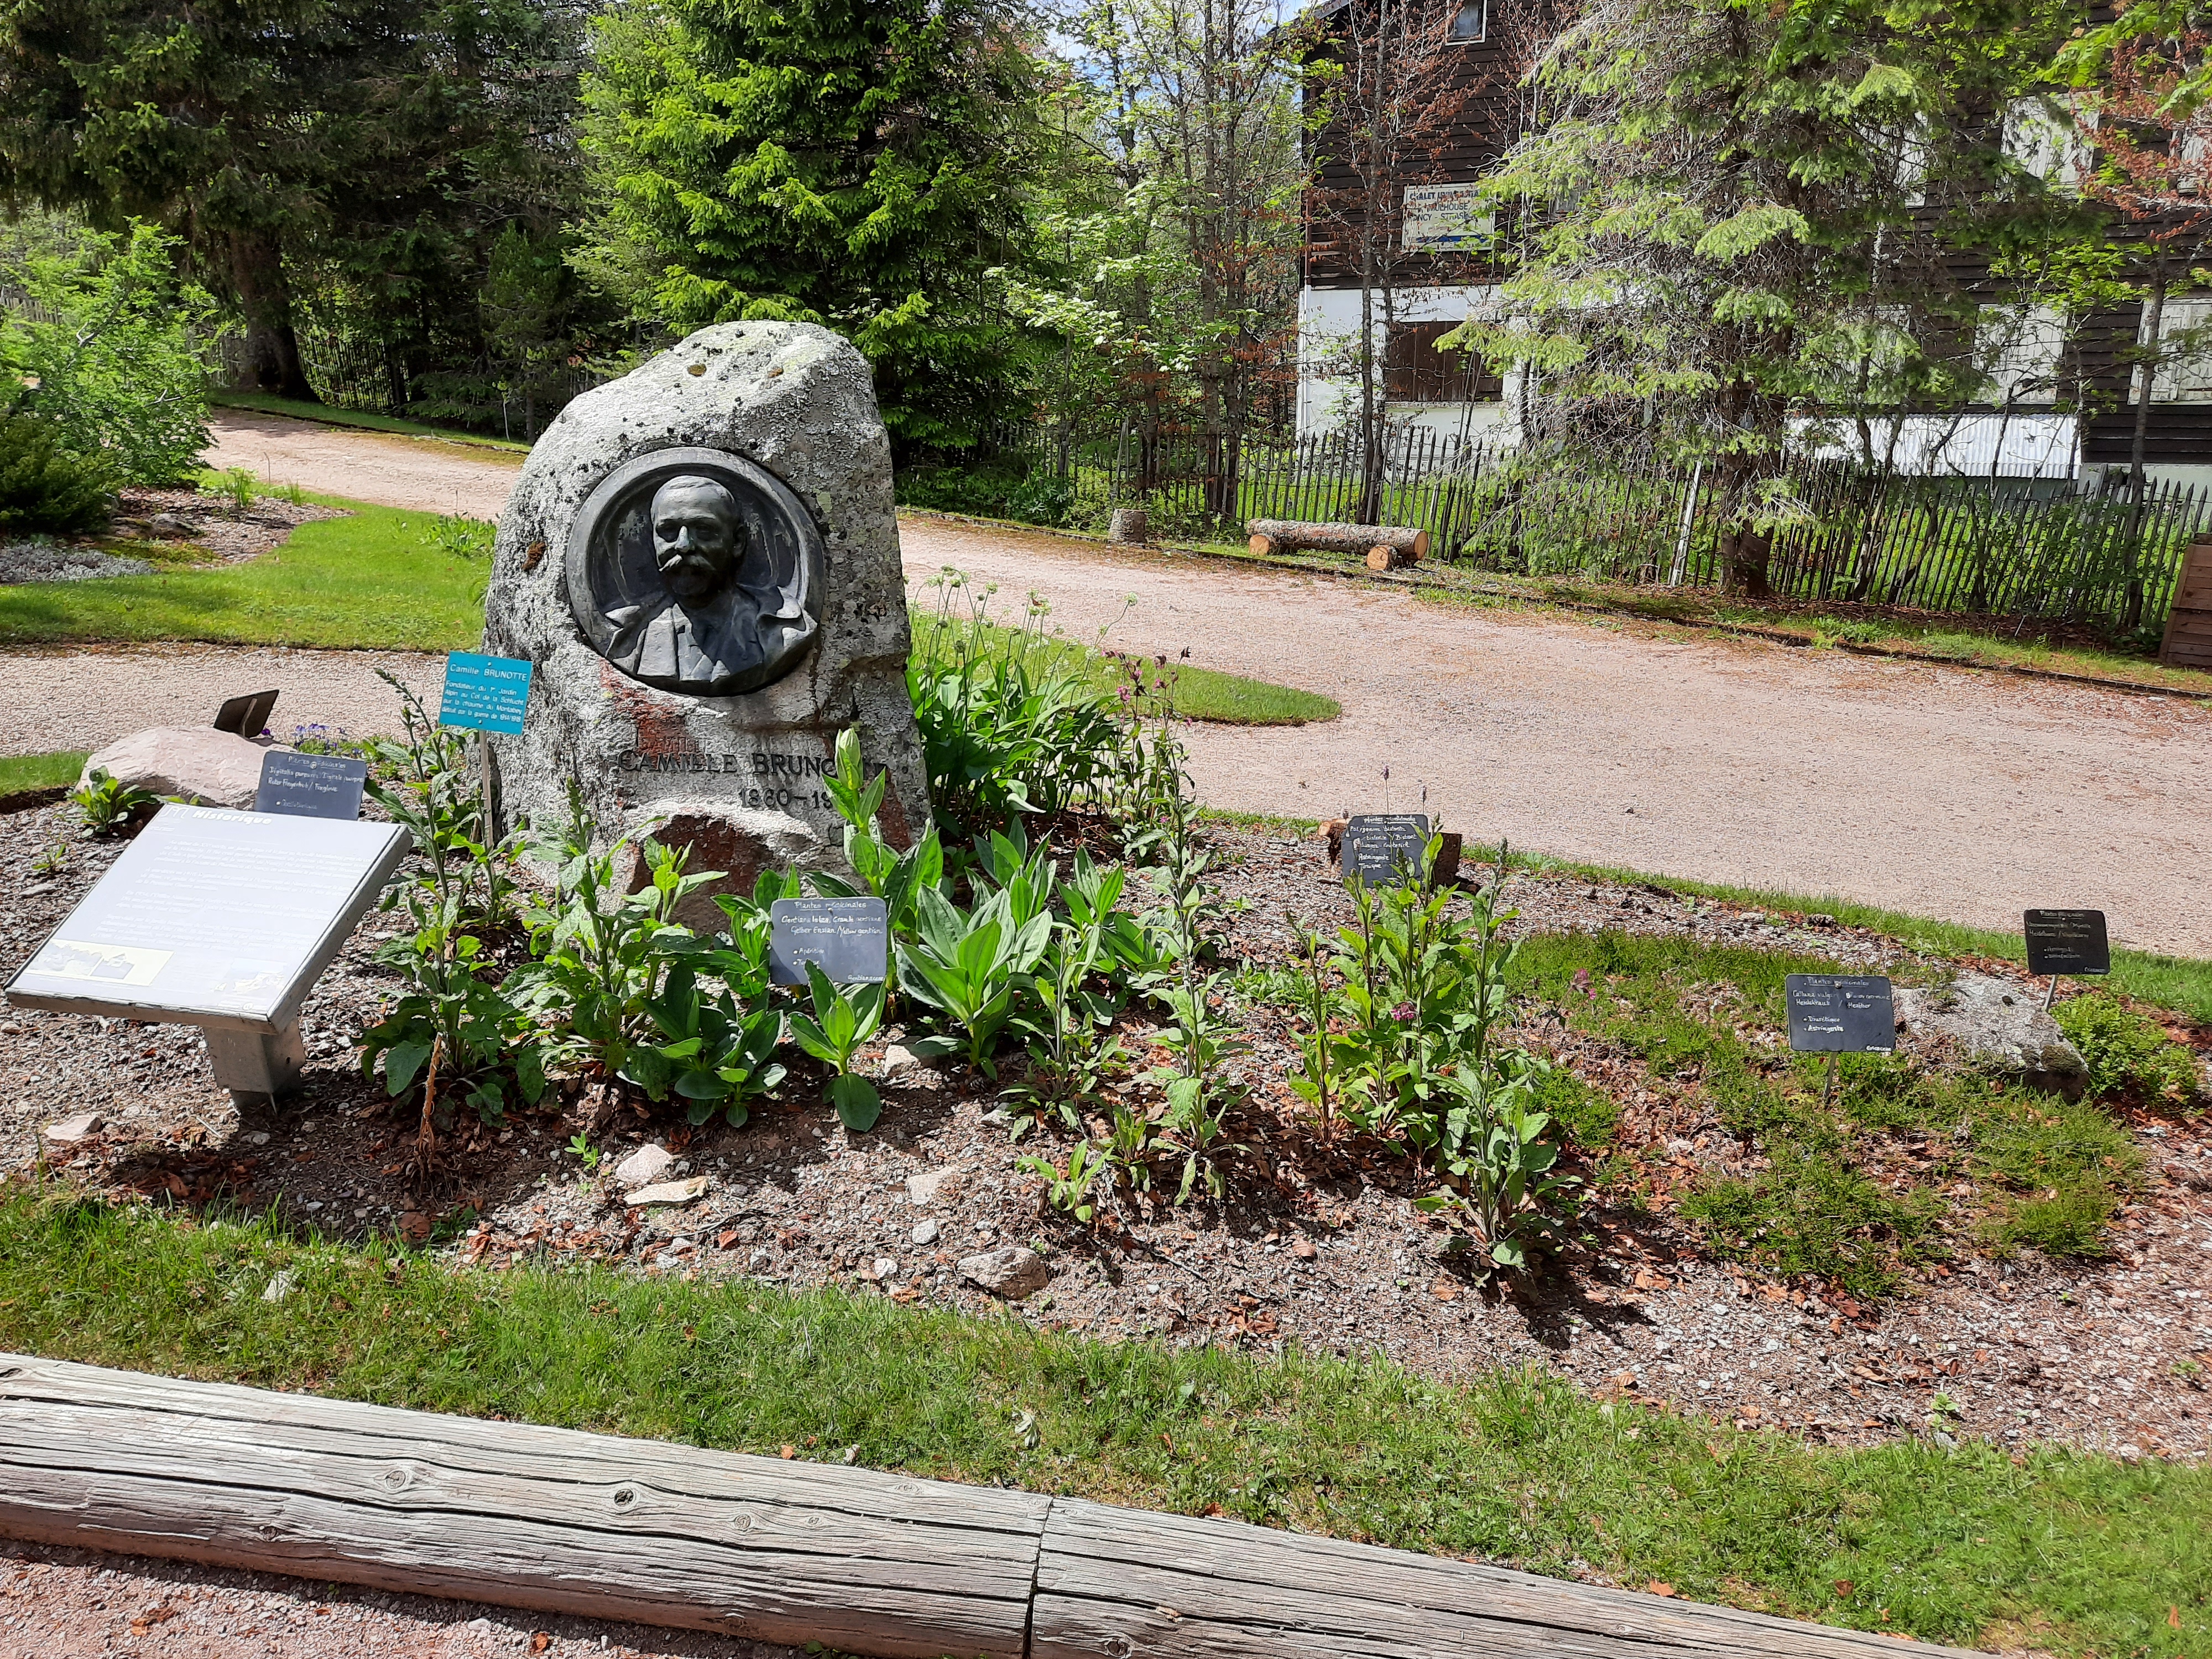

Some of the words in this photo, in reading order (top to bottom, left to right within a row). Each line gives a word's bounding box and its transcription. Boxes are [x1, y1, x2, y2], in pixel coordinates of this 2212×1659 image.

[450, 664, 479, 675] Camille
[484, 668, 528, 681] BRUNOTTE
[445, 680, 476, 690] Fondateur
[462, 700, 484, 708] chaume
[500, 696, 524, 706] Schlucht
[617, 749, 738, 774] CAMILLE
[739, 788, 833, 808] 1860-19
[192, 810, 273, 825] Historique
